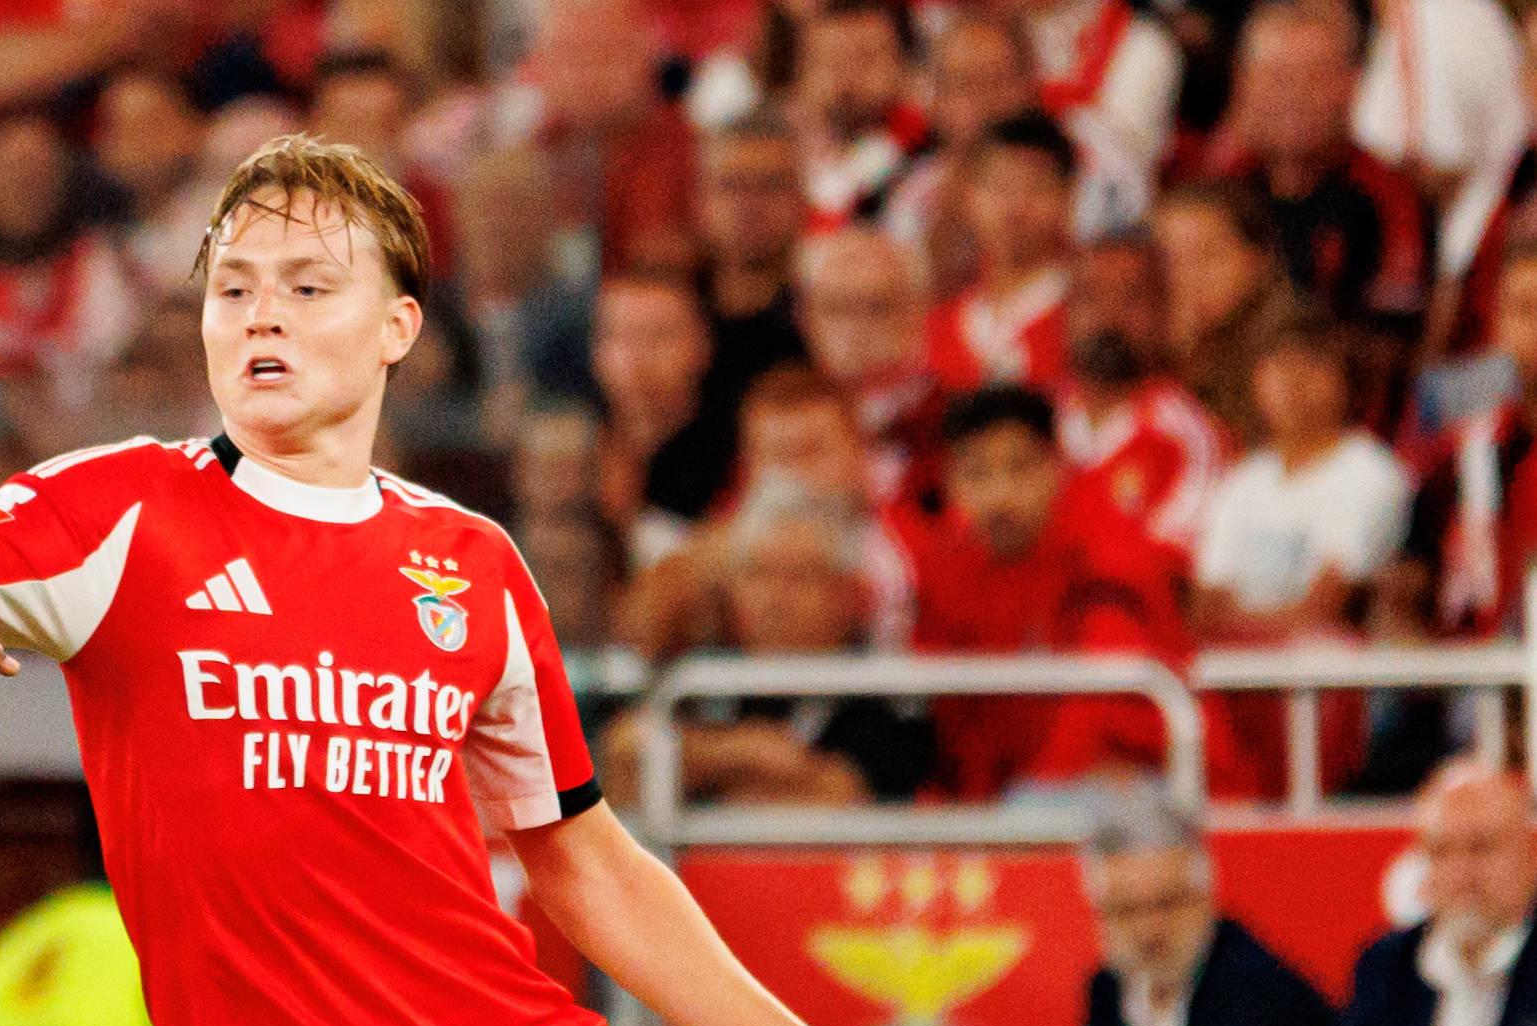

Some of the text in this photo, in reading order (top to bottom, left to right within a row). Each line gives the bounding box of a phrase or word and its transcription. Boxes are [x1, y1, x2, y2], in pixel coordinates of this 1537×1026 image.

[176, 650, 474, 741] Emirates
[243, 733, 452, 803] FLY BETTER
